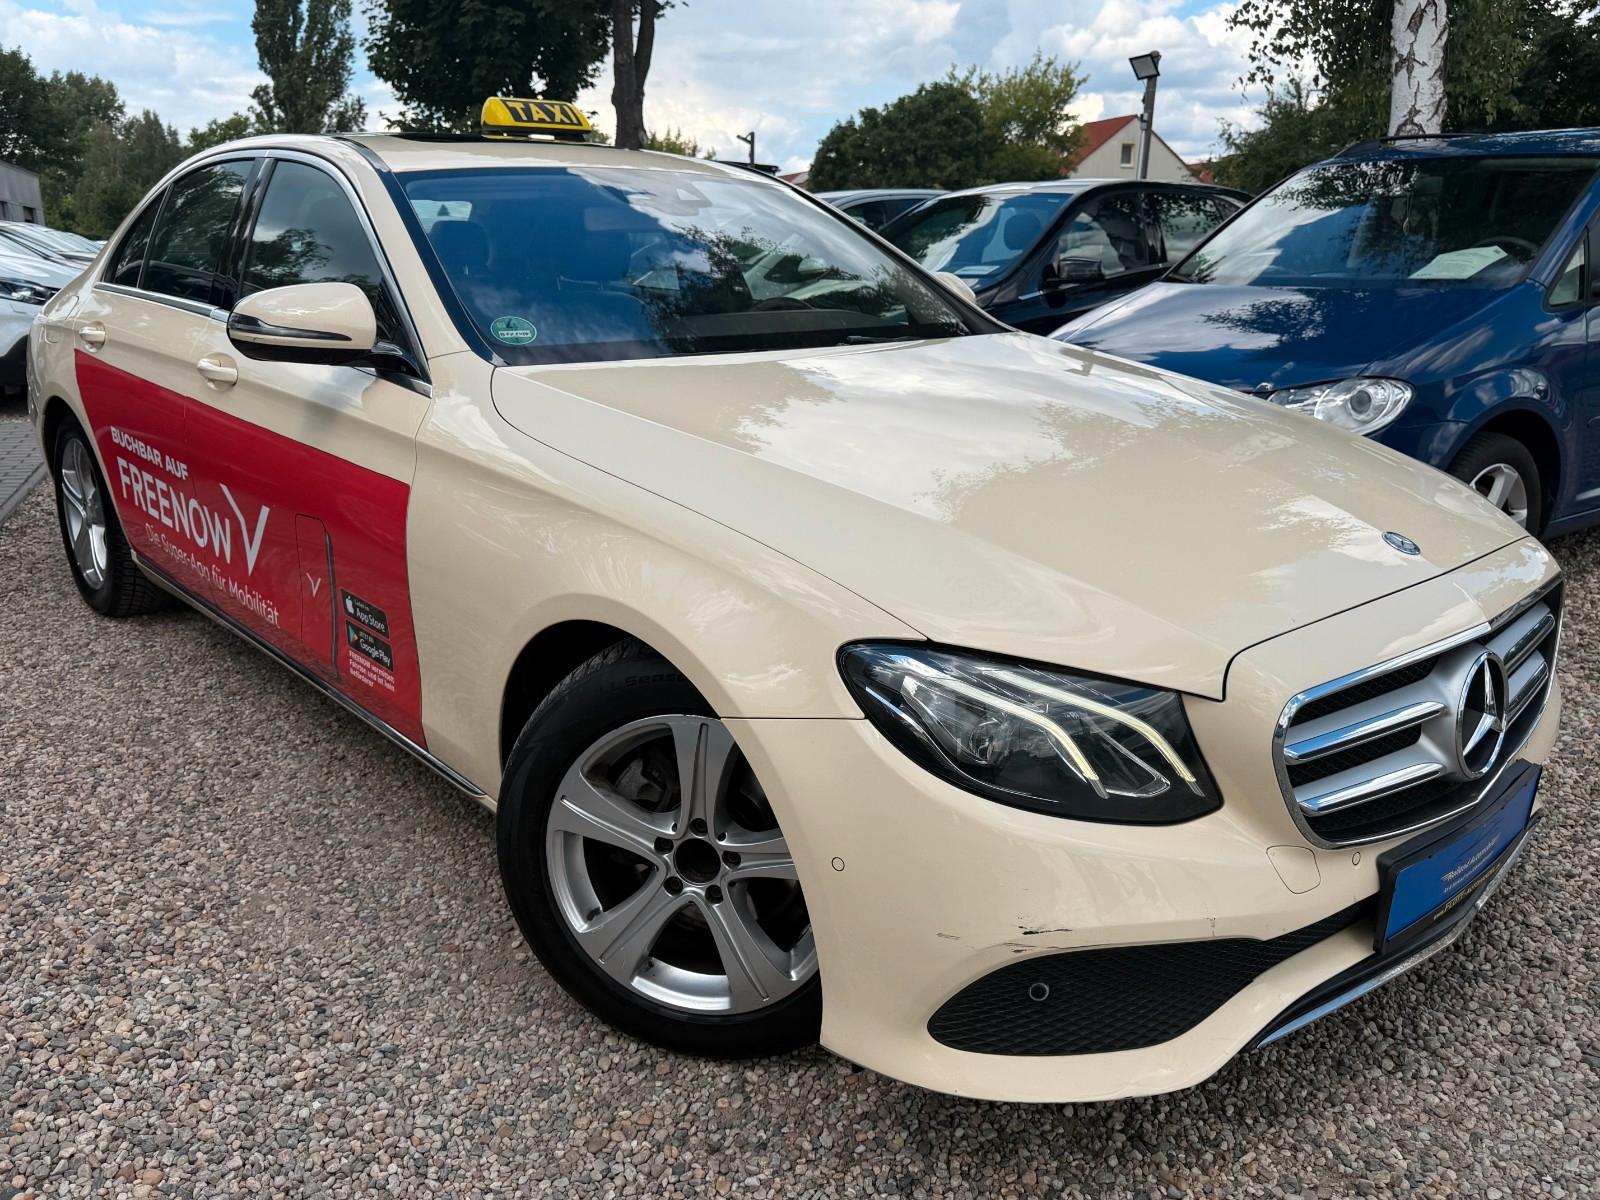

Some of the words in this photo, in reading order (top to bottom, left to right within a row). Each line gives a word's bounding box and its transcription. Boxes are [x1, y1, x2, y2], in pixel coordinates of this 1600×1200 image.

[505, 101, 579, 124] TAXI
[110, 426, 163, 469] BUCHBAR
[165, 455, 189, 480] AUF
[116, 456, 231, 564] FREENOW
[145, 523, 161, 547] Die
[161, 533, 211, 581] Super-App
[212, 564, 227, 592] für
[228, 576, 280, 629] Mobilität
[356, 608, 369, 624] App
[368, 615, 386, 632] Store
[360, 638, 379, 658] Google
[379, 649, 391, 667] Play
